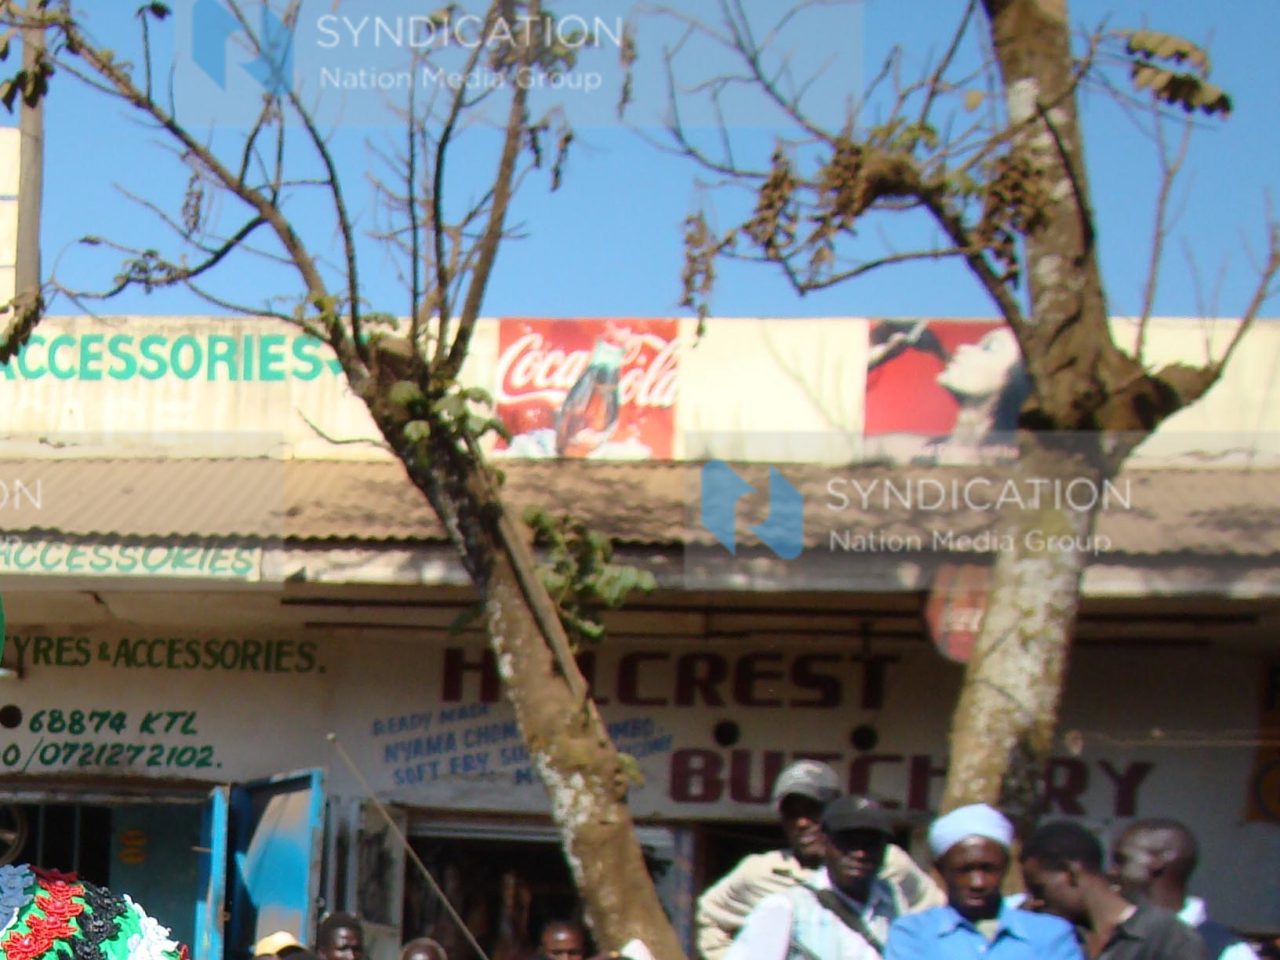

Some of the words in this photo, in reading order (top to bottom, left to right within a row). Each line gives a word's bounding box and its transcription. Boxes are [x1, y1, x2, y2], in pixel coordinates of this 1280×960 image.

[442, 647, 902, 709] HLCREST
[28, 709, 127, 736] 68874
[139, 710, 199, 735] KTL
[670, 747, 1154, 817] BUCHRY
